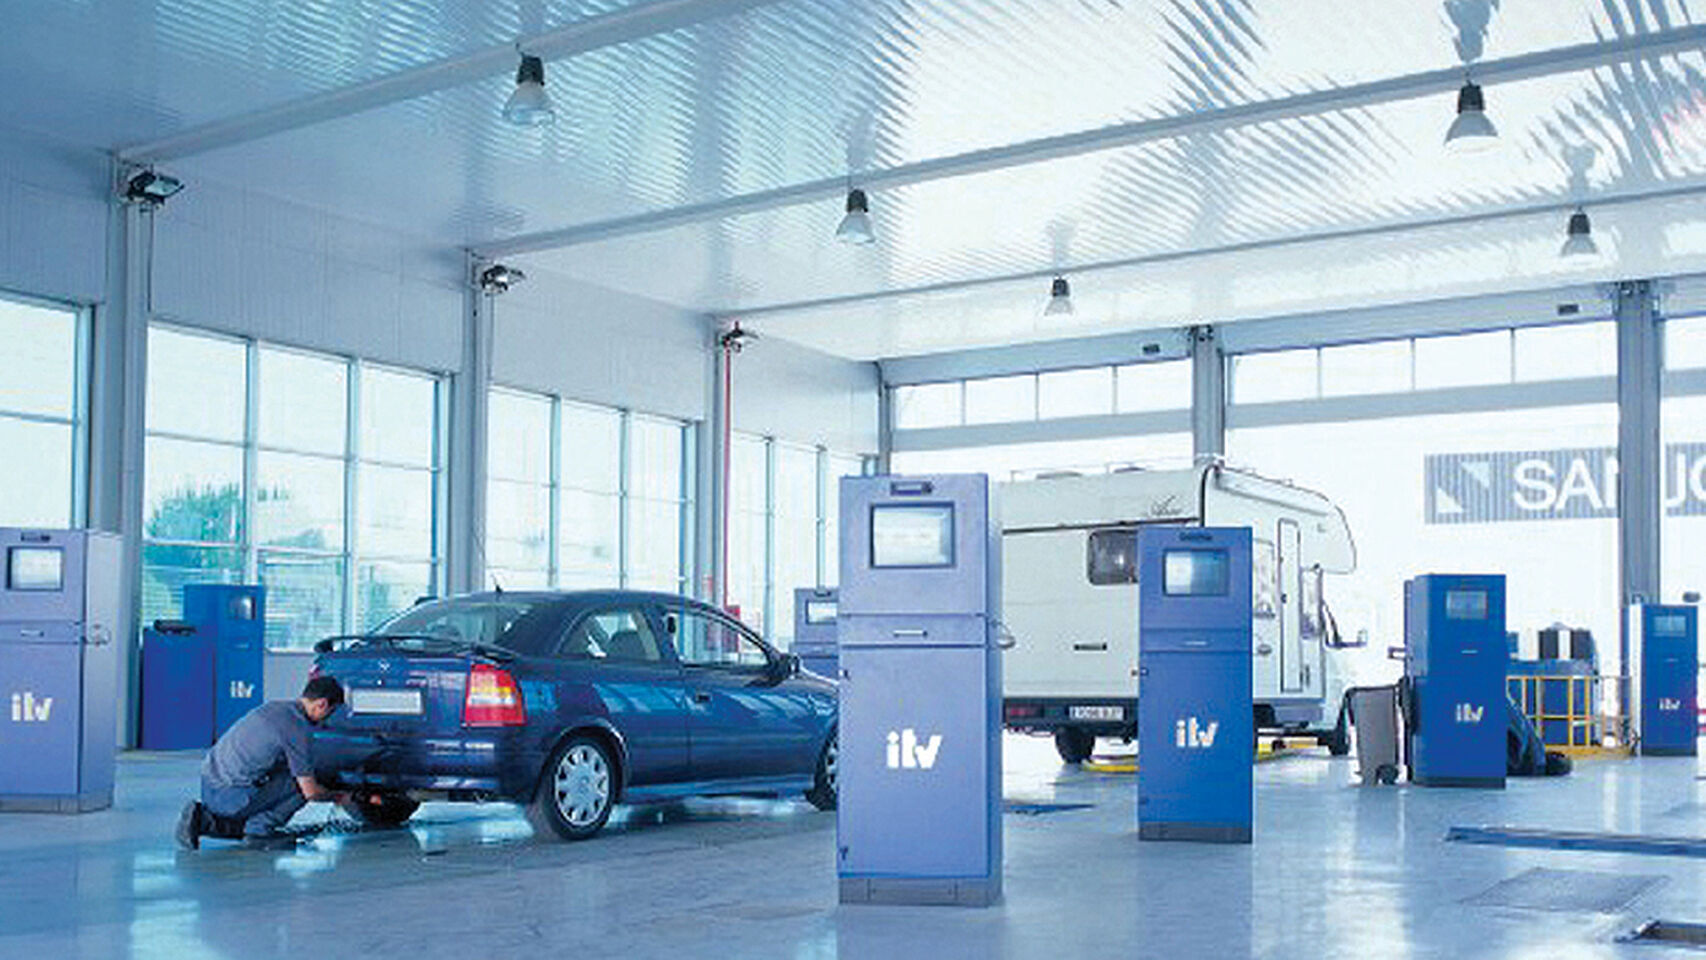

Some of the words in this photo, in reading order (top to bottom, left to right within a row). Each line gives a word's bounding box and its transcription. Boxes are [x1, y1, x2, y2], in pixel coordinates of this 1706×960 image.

[230, 680, 254, 699] itv
[12, 693, 52, 721] itv
[1456, 703, 1484, 722] itv
[1176, 717, 1218, 747] itv
[886, 729, 942, 769] itv
